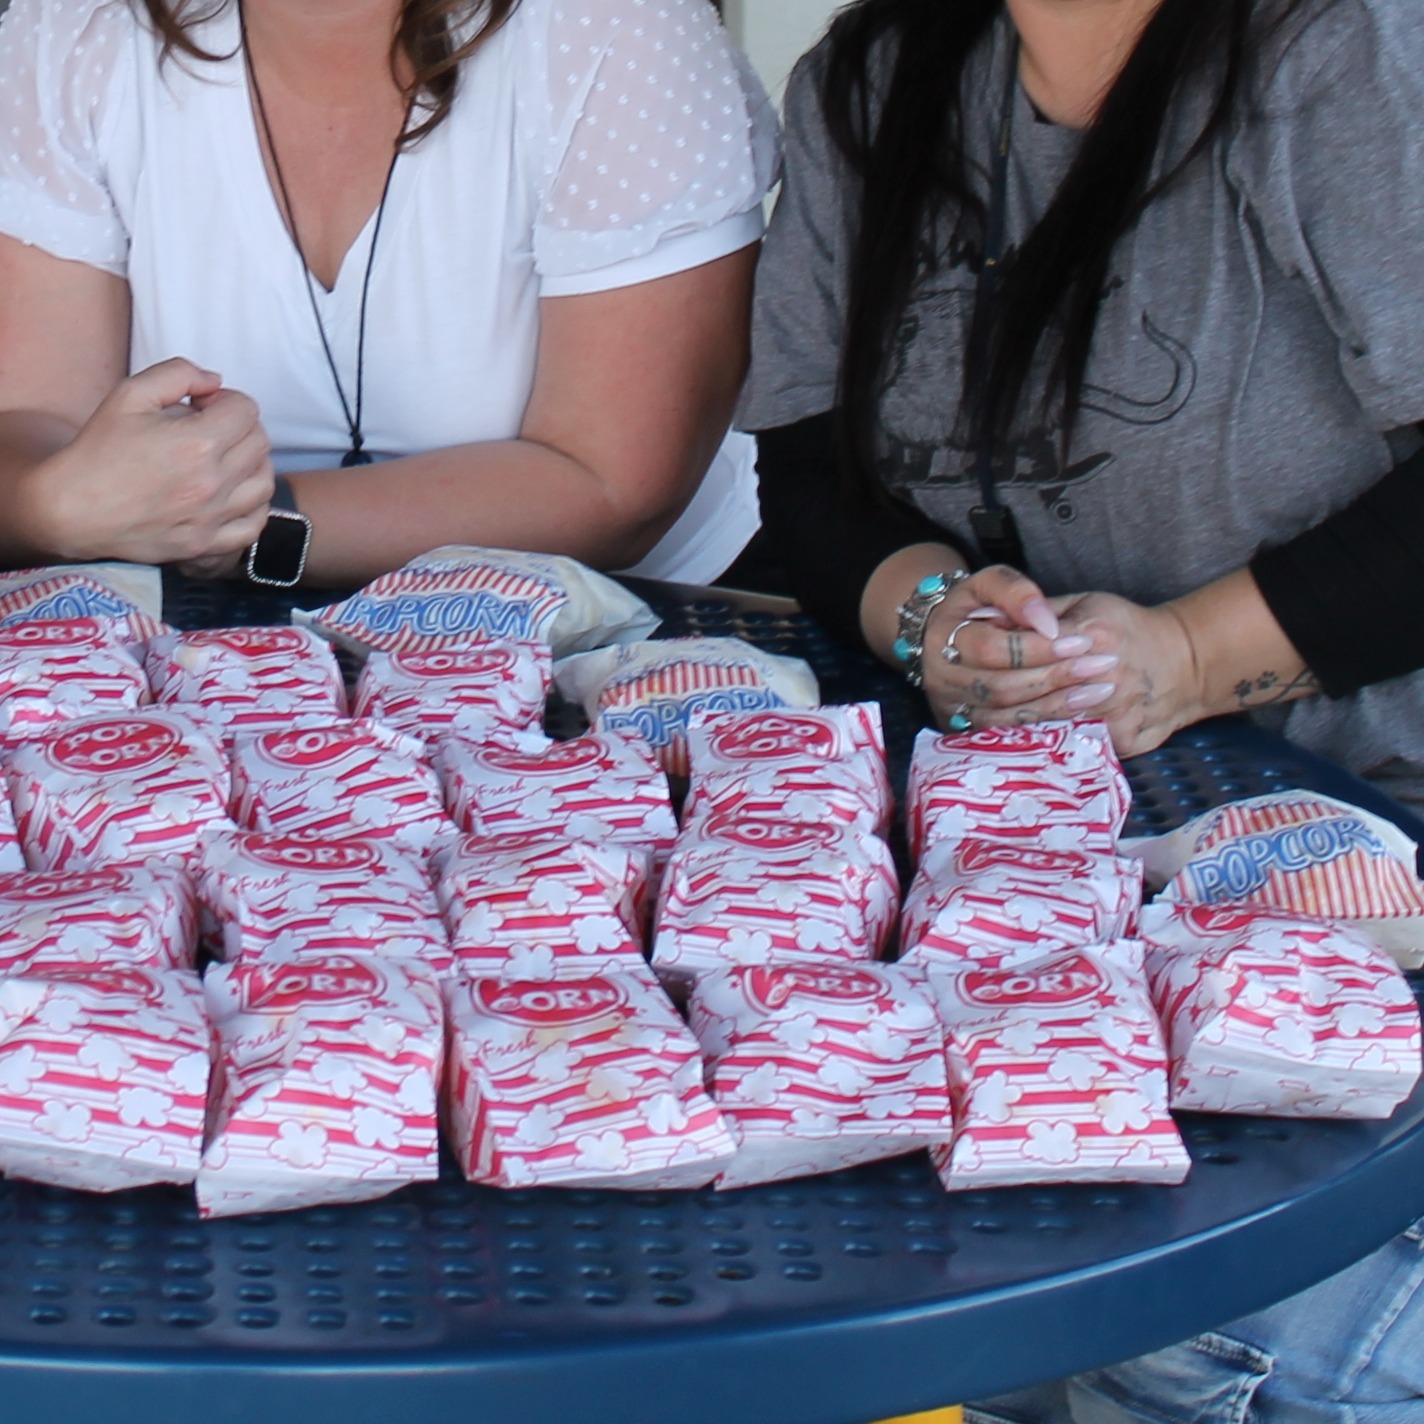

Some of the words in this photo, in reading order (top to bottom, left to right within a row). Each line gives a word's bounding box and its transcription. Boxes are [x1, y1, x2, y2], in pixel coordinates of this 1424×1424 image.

[337, 590, 533, 640] POPCORN
[62, 733, 171, 766] CORN
[64, 723, 150, 750] POP
[251, 847, 371, 864] CORN
[489, 986, 619, 1012] CORN
[969, 972, 1102, 1000] CORN
